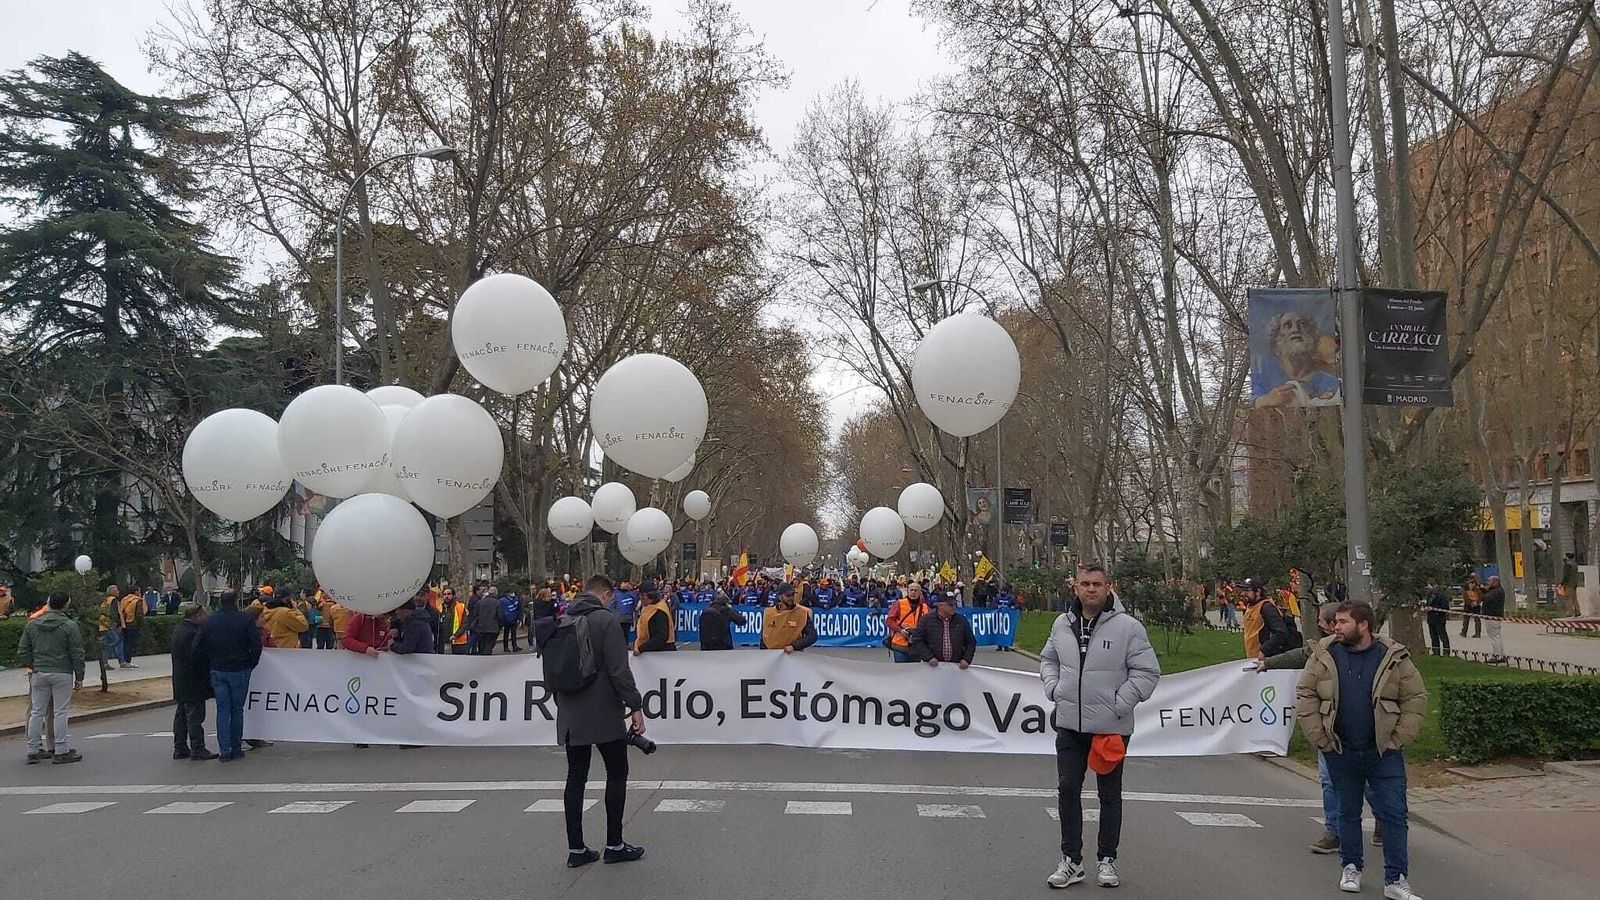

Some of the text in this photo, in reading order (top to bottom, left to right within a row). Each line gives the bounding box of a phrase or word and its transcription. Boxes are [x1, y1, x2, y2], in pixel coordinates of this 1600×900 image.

[1368, 331, 1442, 346] CARRACCI
[461, 342, 507, 360] FENACORE
[929, 392, 995, 406] FENACORE
[1395, 395, 1428, 403] MADRID
[635, 426, 686, 440] FENACORE
[346, 453, 390, 471] FENACO
[813, 612, 861, 637] REGADIO
[247, 676, 398, 717] FENACORE
[436, 679, 508, 722] Sin
[739, 678, 972, 739] Estómago
